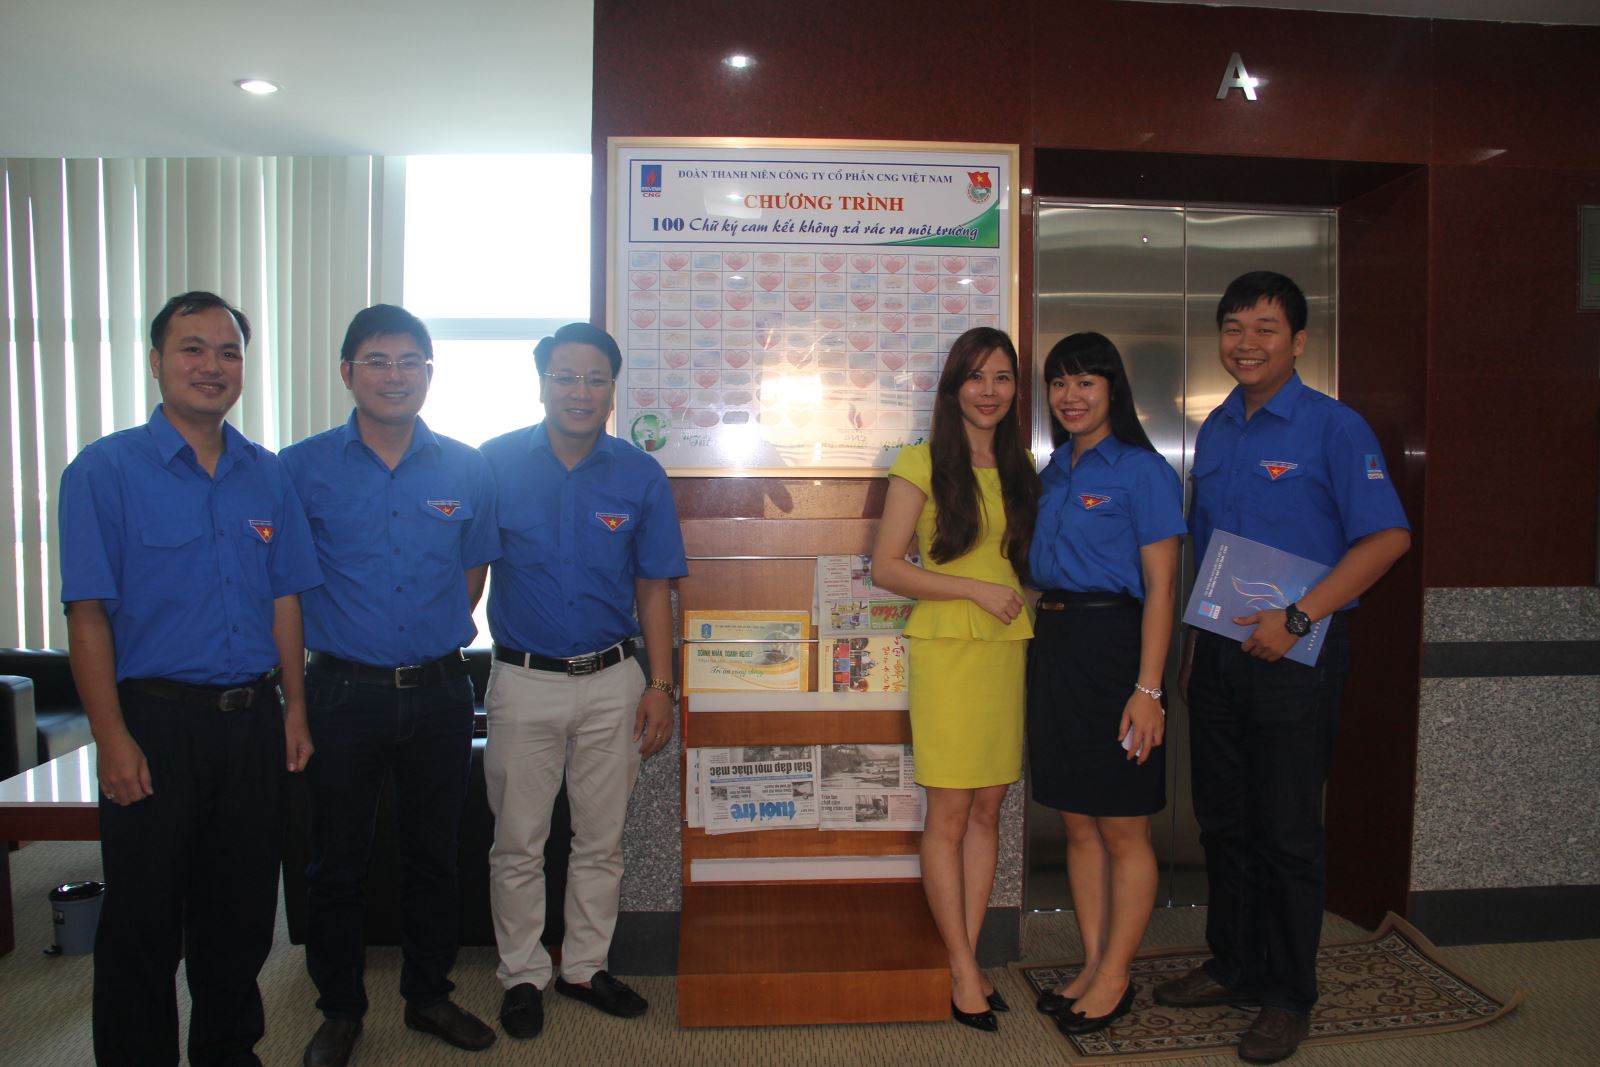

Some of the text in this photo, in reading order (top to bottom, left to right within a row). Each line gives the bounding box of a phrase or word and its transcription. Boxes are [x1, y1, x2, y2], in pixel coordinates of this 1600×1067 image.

[1216, 52, 1257, 100] A
[678, 168, 708, 180] ĐOÀN
[711, 170, 748, 180] THANH
[751, 169, 777, 180] NIÊN
[778, 169, 809, 181] CÔNG
[812, 172, 826, 181] TY
[877, 173, 900, 182] CNG
[901, 172, 927, 184] VIỆT
[929, 175, 953, 184] NAM
[743, 192, 904, 212] CHƯƠNG TRÌNH
[652, 217, 685, 232] 100
[689, 217, 720, 232] Chữ
[721, 218, 739, 237] ký
[741, 224, 768, 233] cam
[772, 219, 795, 233] kết
[799, 219, 839, 238] không
[842, 220, 861, 234] xả
[864, 223, 885, 235] rác
[889, 226, 904, 235] ra
[908, 224, 932, 236] môi
[755, 763, 773, 774] mọi
[774, 762, 793, 775] đáp
